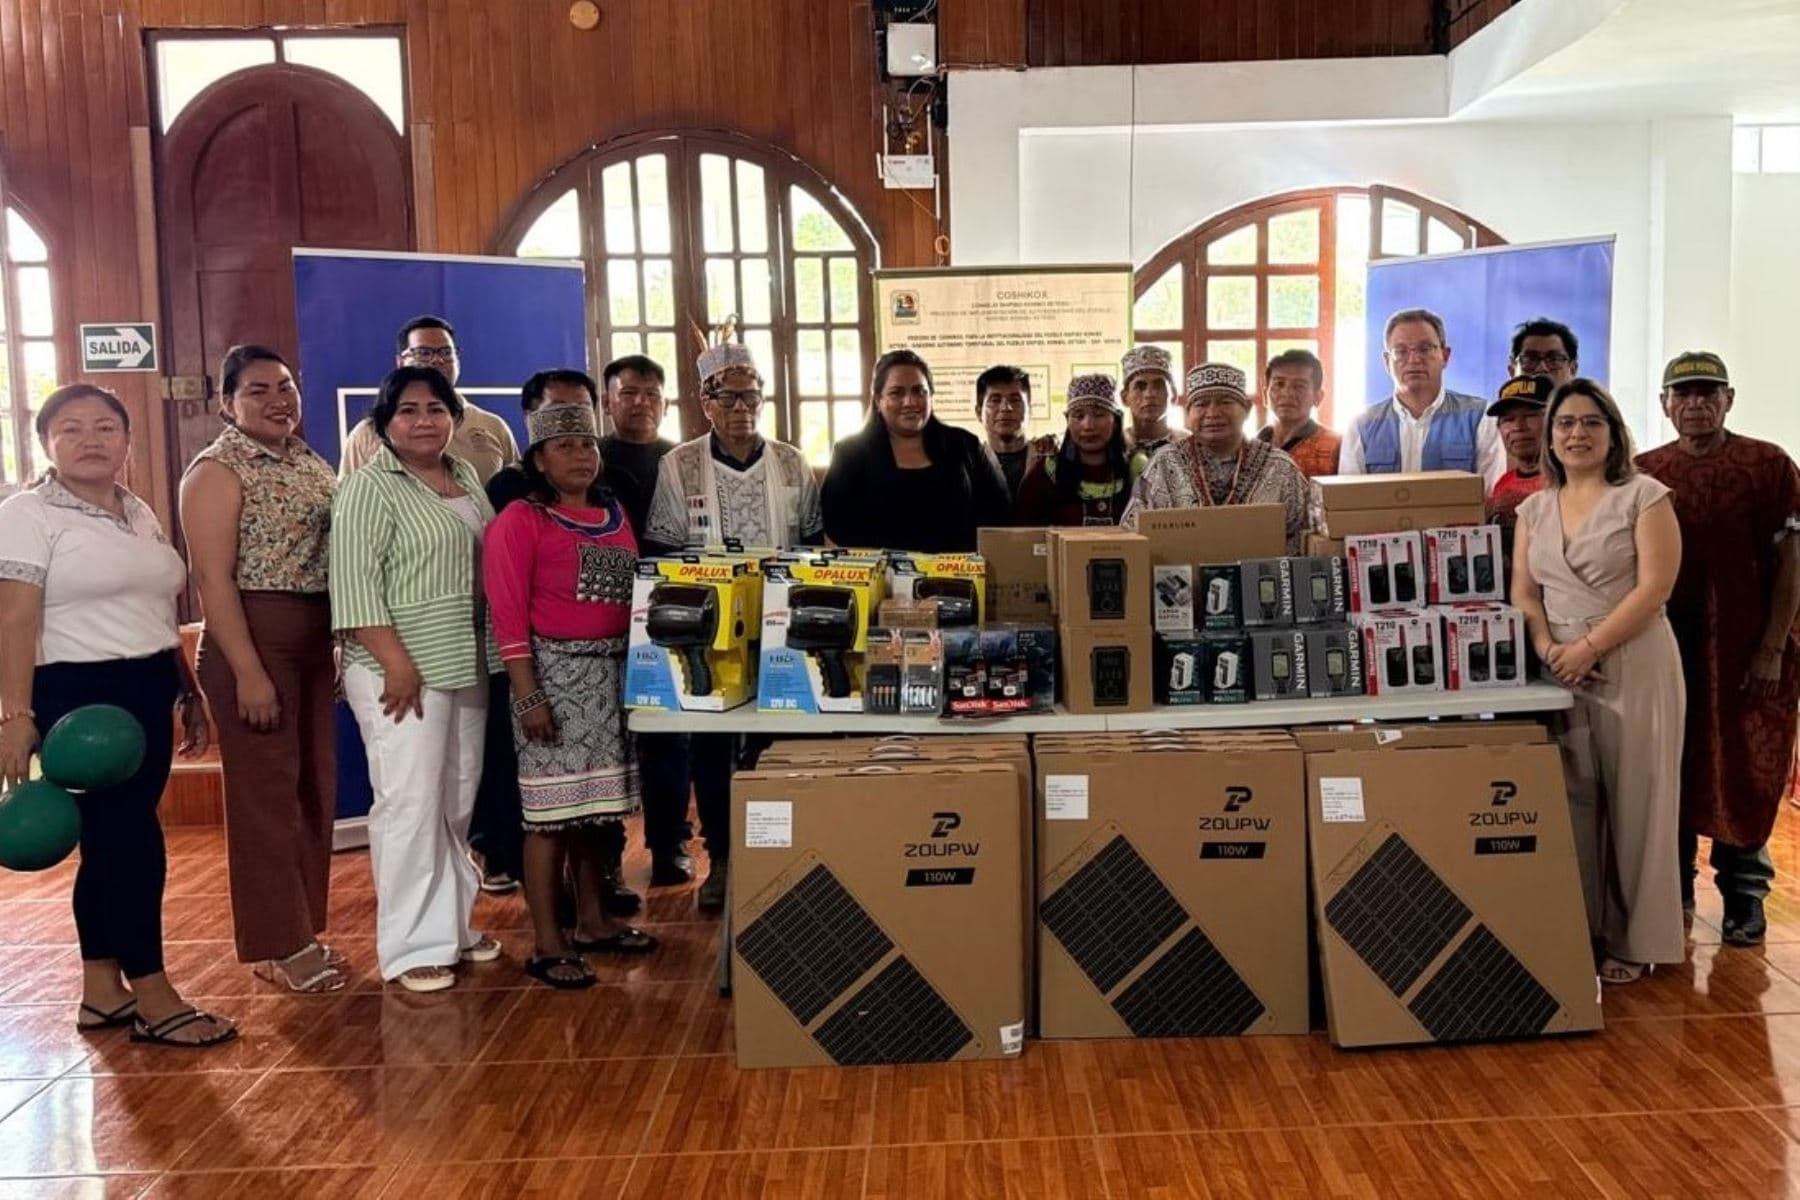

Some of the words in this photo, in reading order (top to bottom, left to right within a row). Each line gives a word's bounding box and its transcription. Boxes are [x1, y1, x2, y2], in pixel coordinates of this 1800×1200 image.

[90, 341, 141, 354] SALIDA
[1152, 521, 1195, 529] STARLINK
[680, 566, 728, 577] OPALUX
[814, 569, 865, 580] OPALUX
[936, 563, 983, 573] OPALUX
[1280, 559, 1292, 615] GARMIN
[1331, 556, 1344, 612] GARMIN
[1294, 632, 1306, 689] GARMIN
[1348, 630, 1360, 688] GARMIN
[1199, 817, 1271, 830] ZOUPW
[1468, 811, 1538, 827] ZOUPW
[904, 842, 979, 857] ZOUPW
[1218, 845, 1248, 856] 110W
[1490, 839, 1520, 851] 110W
[925, 871, 957, 882] 110W
